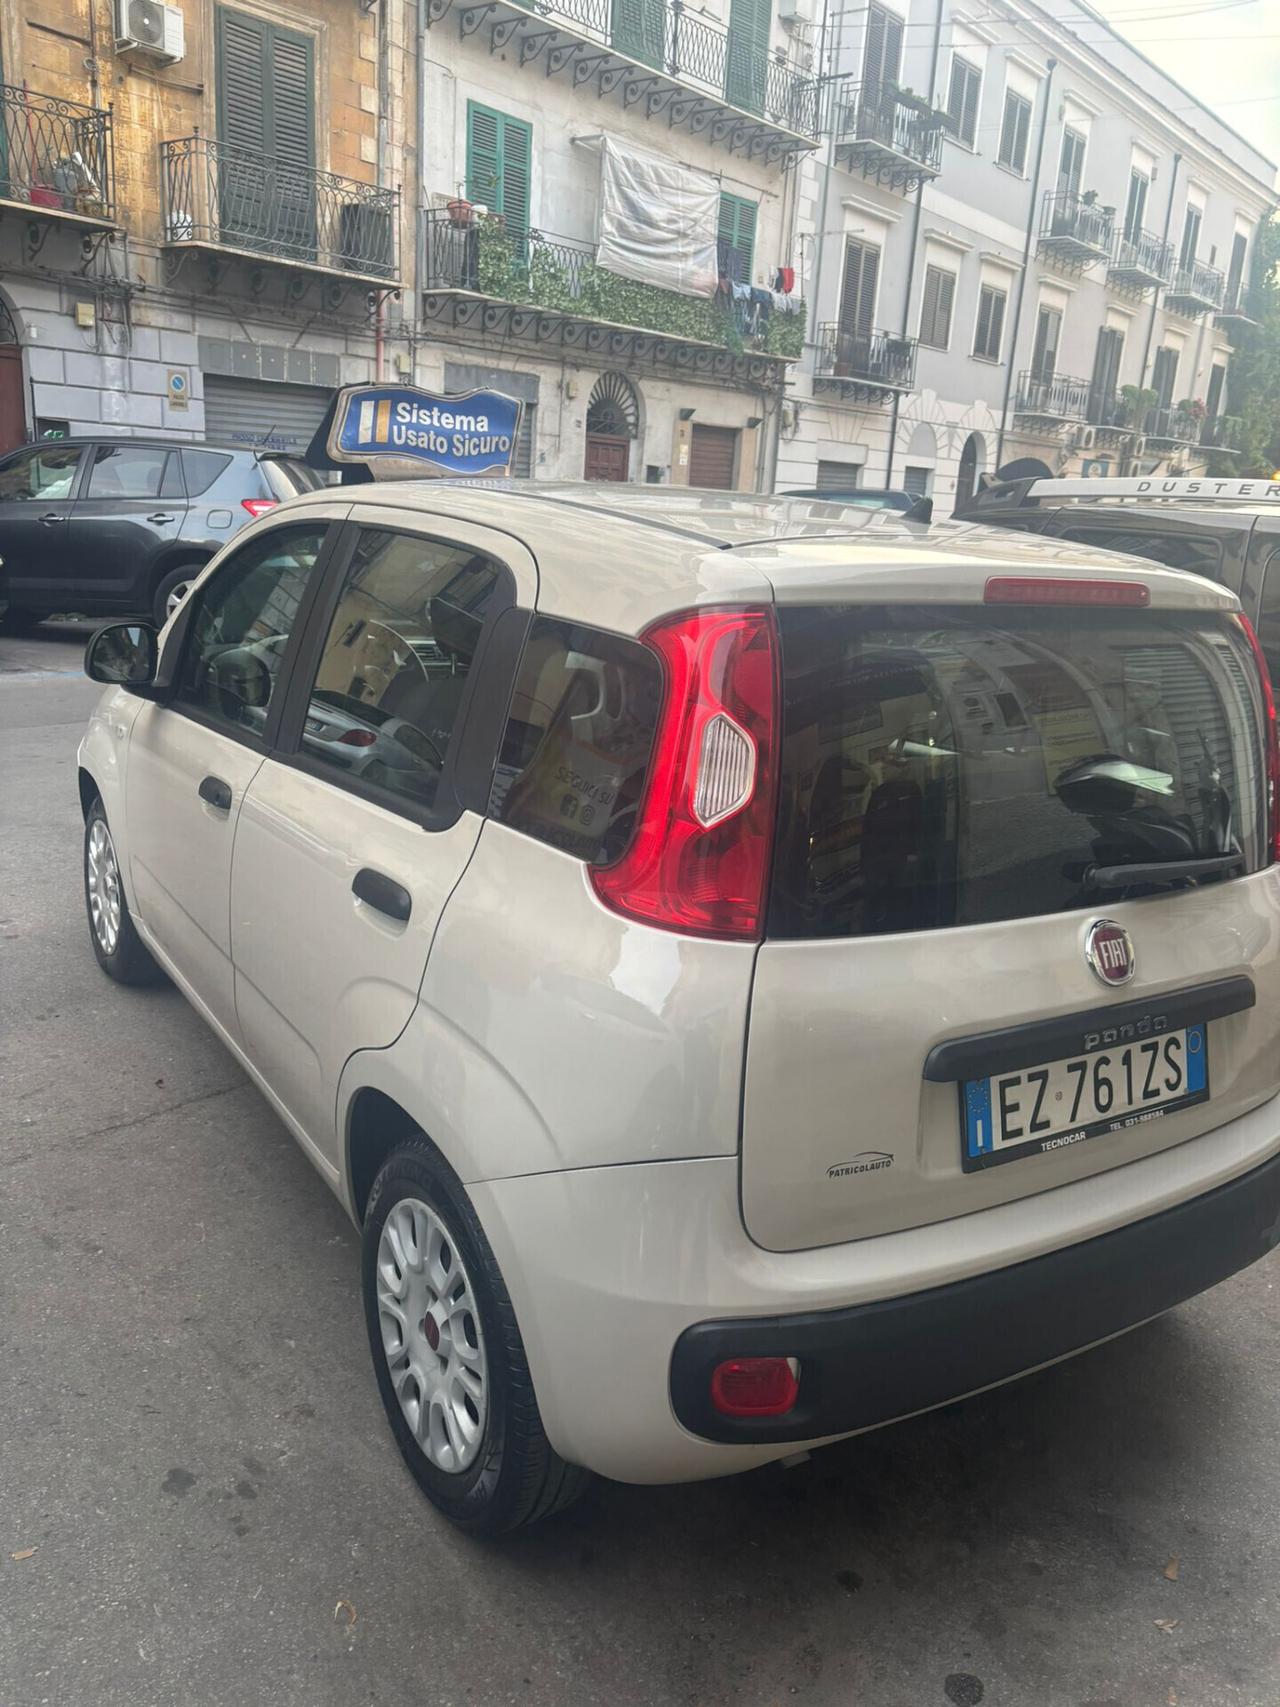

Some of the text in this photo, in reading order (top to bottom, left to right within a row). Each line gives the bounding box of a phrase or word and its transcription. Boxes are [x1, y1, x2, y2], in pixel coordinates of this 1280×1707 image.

[396, 402, 488, 432] Sistema
[393, 425, 510, 457] Usato Sicuro
[1136, 481, 1280, 497] DUSTER
[1098, 938, 1127, 969] FIAT
[999, 1036, 1183, 1141] EZ 761ZS
[1041, 1131, 1086, 1151] TECNOCAR
[829, 1159, 892, 1179] PATRICOLAUTO
